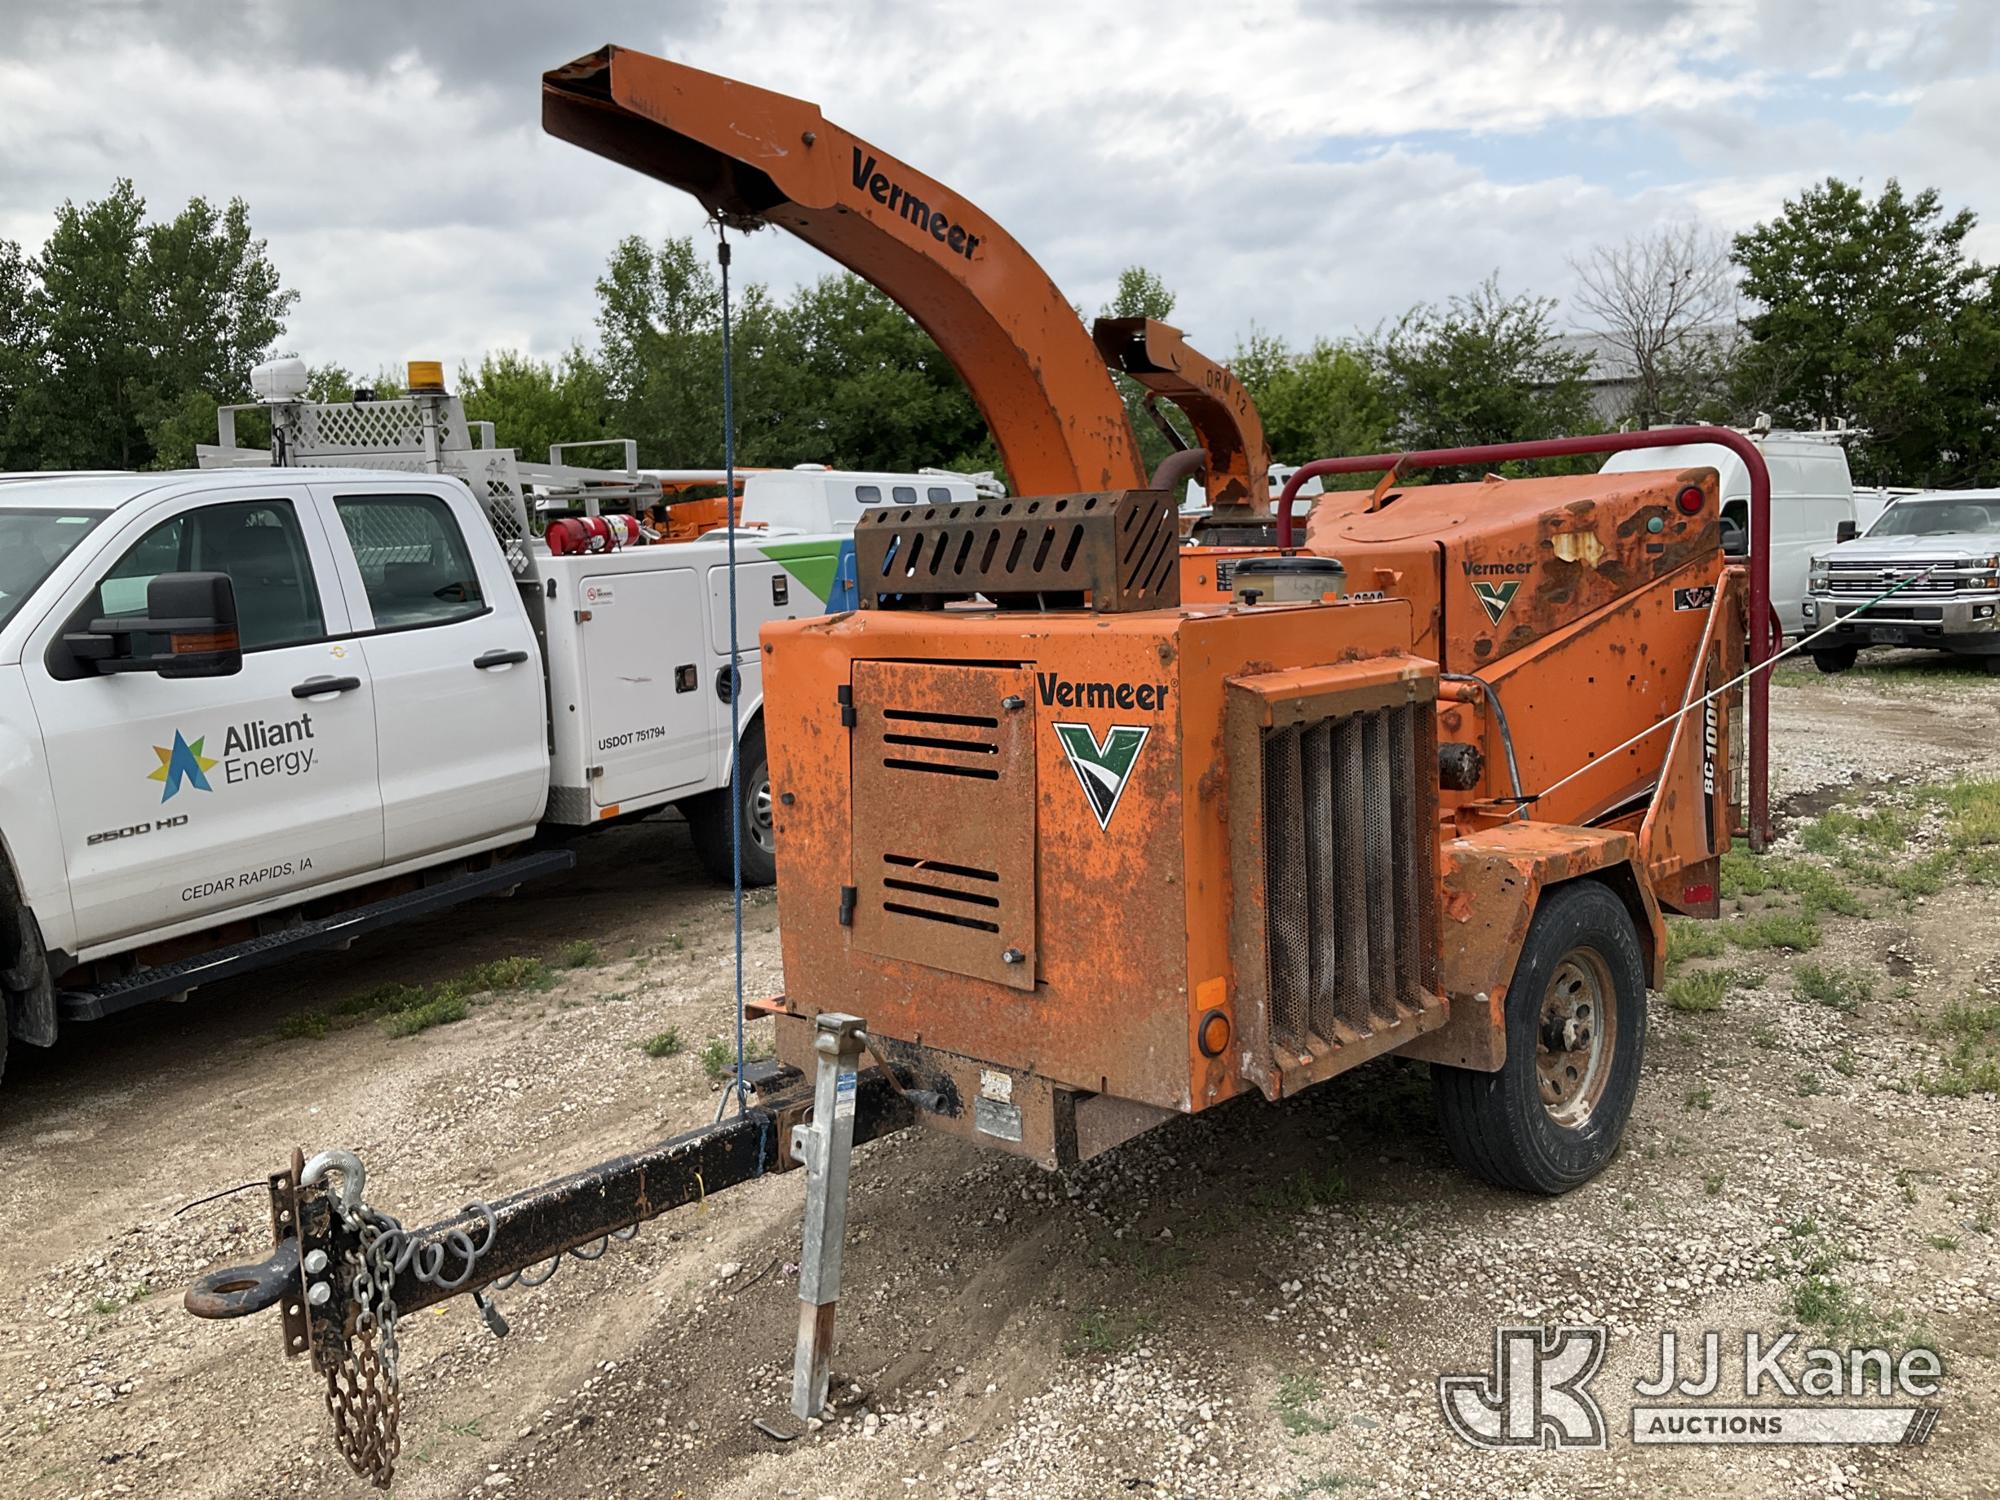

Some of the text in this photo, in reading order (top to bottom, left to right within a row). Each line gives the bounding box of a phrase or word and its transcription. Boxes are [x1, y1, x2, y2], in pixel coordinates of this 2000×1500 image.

[852, 145, 980, 261] Vermeer
[1461, 560, 1534, 576] Vermeer
[1036, 672, 1169, 711] Vermeer
[223, 713, 315, 757] Alliant
[598, 725, 665, 751] USDOT 751794
[224, 747, 314, 785] Energy
[86, 814, 189, 847] 2500 HD
[181, 856, 313, 902] CEDAR RAPIDS, IA
